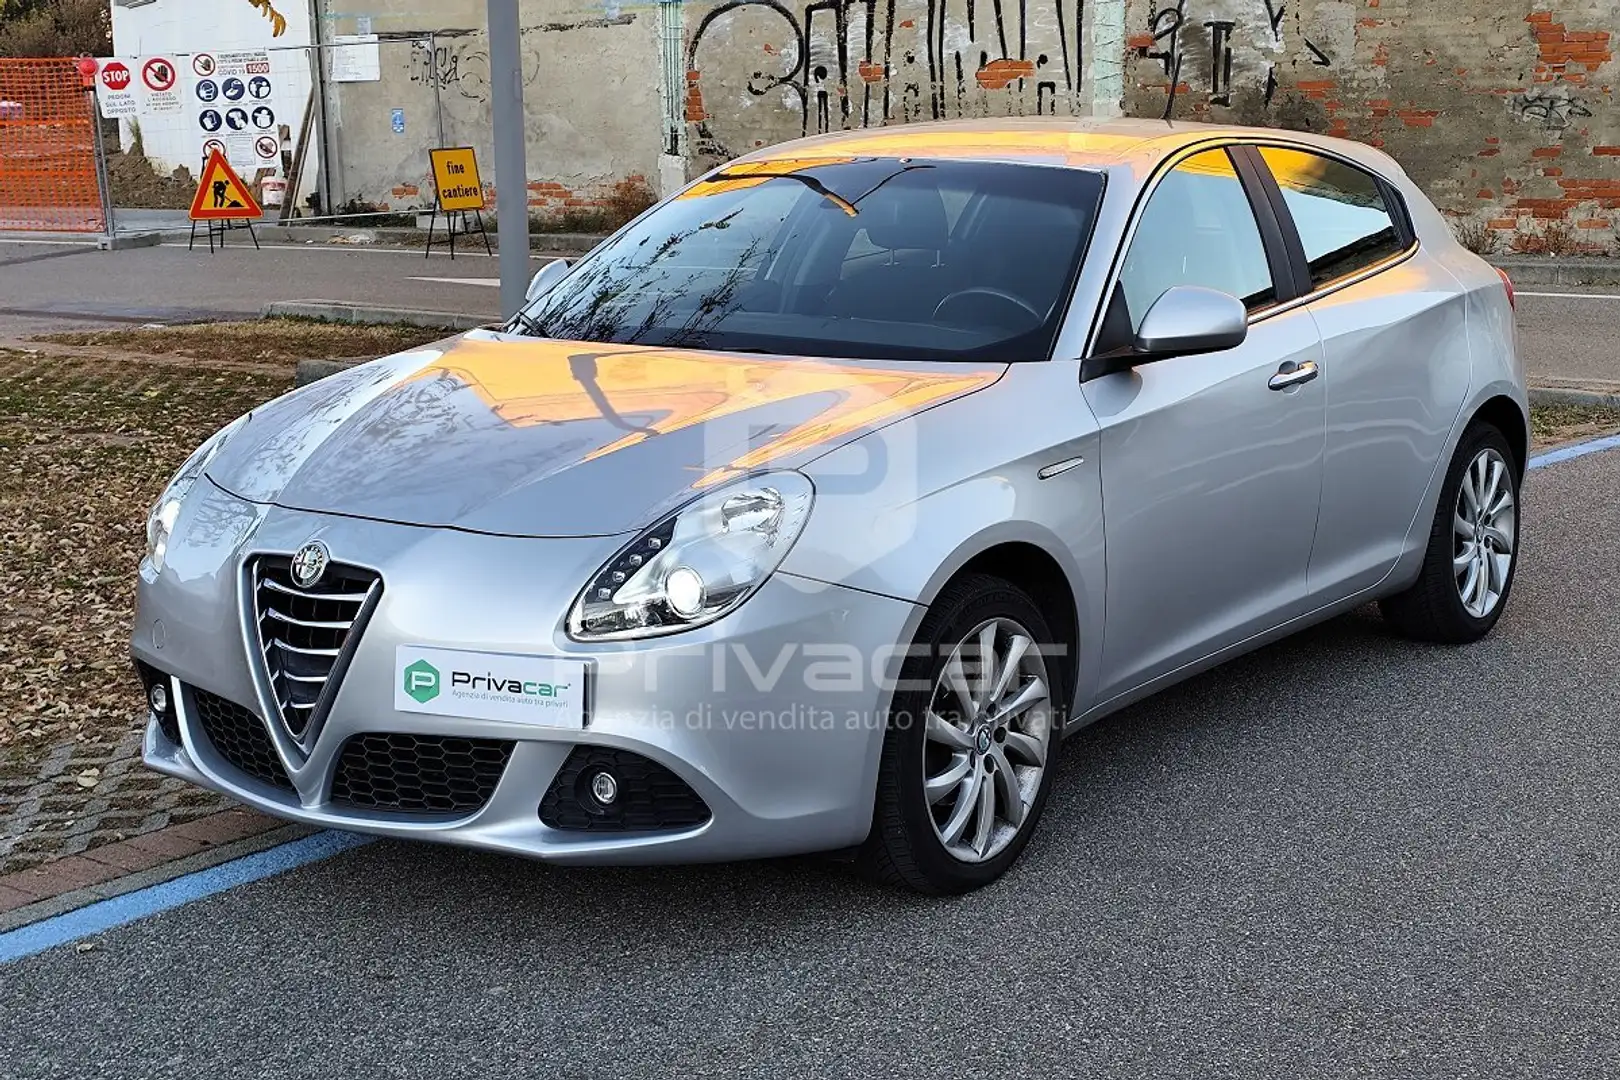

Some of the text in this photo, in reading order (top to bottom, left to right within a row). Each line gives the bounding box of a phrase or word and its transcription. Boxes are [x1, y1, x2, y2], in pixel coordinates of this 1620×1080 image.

[247, 64, 269, 73] 1500
[102, 70, 130, 83] STOP
[106, 107, 137, 115] OPPOSTO
[446, 160, 465, 175] fine
[442, 184, 478, 199] cantiere
[451, 671, 569, 698] Privacar
[452, 690, 480, 701] Agenzia
[489, 693, 516, 703] vendita
[516, 696, 534, 705] auto
[545, 699, 569, 709] privati
